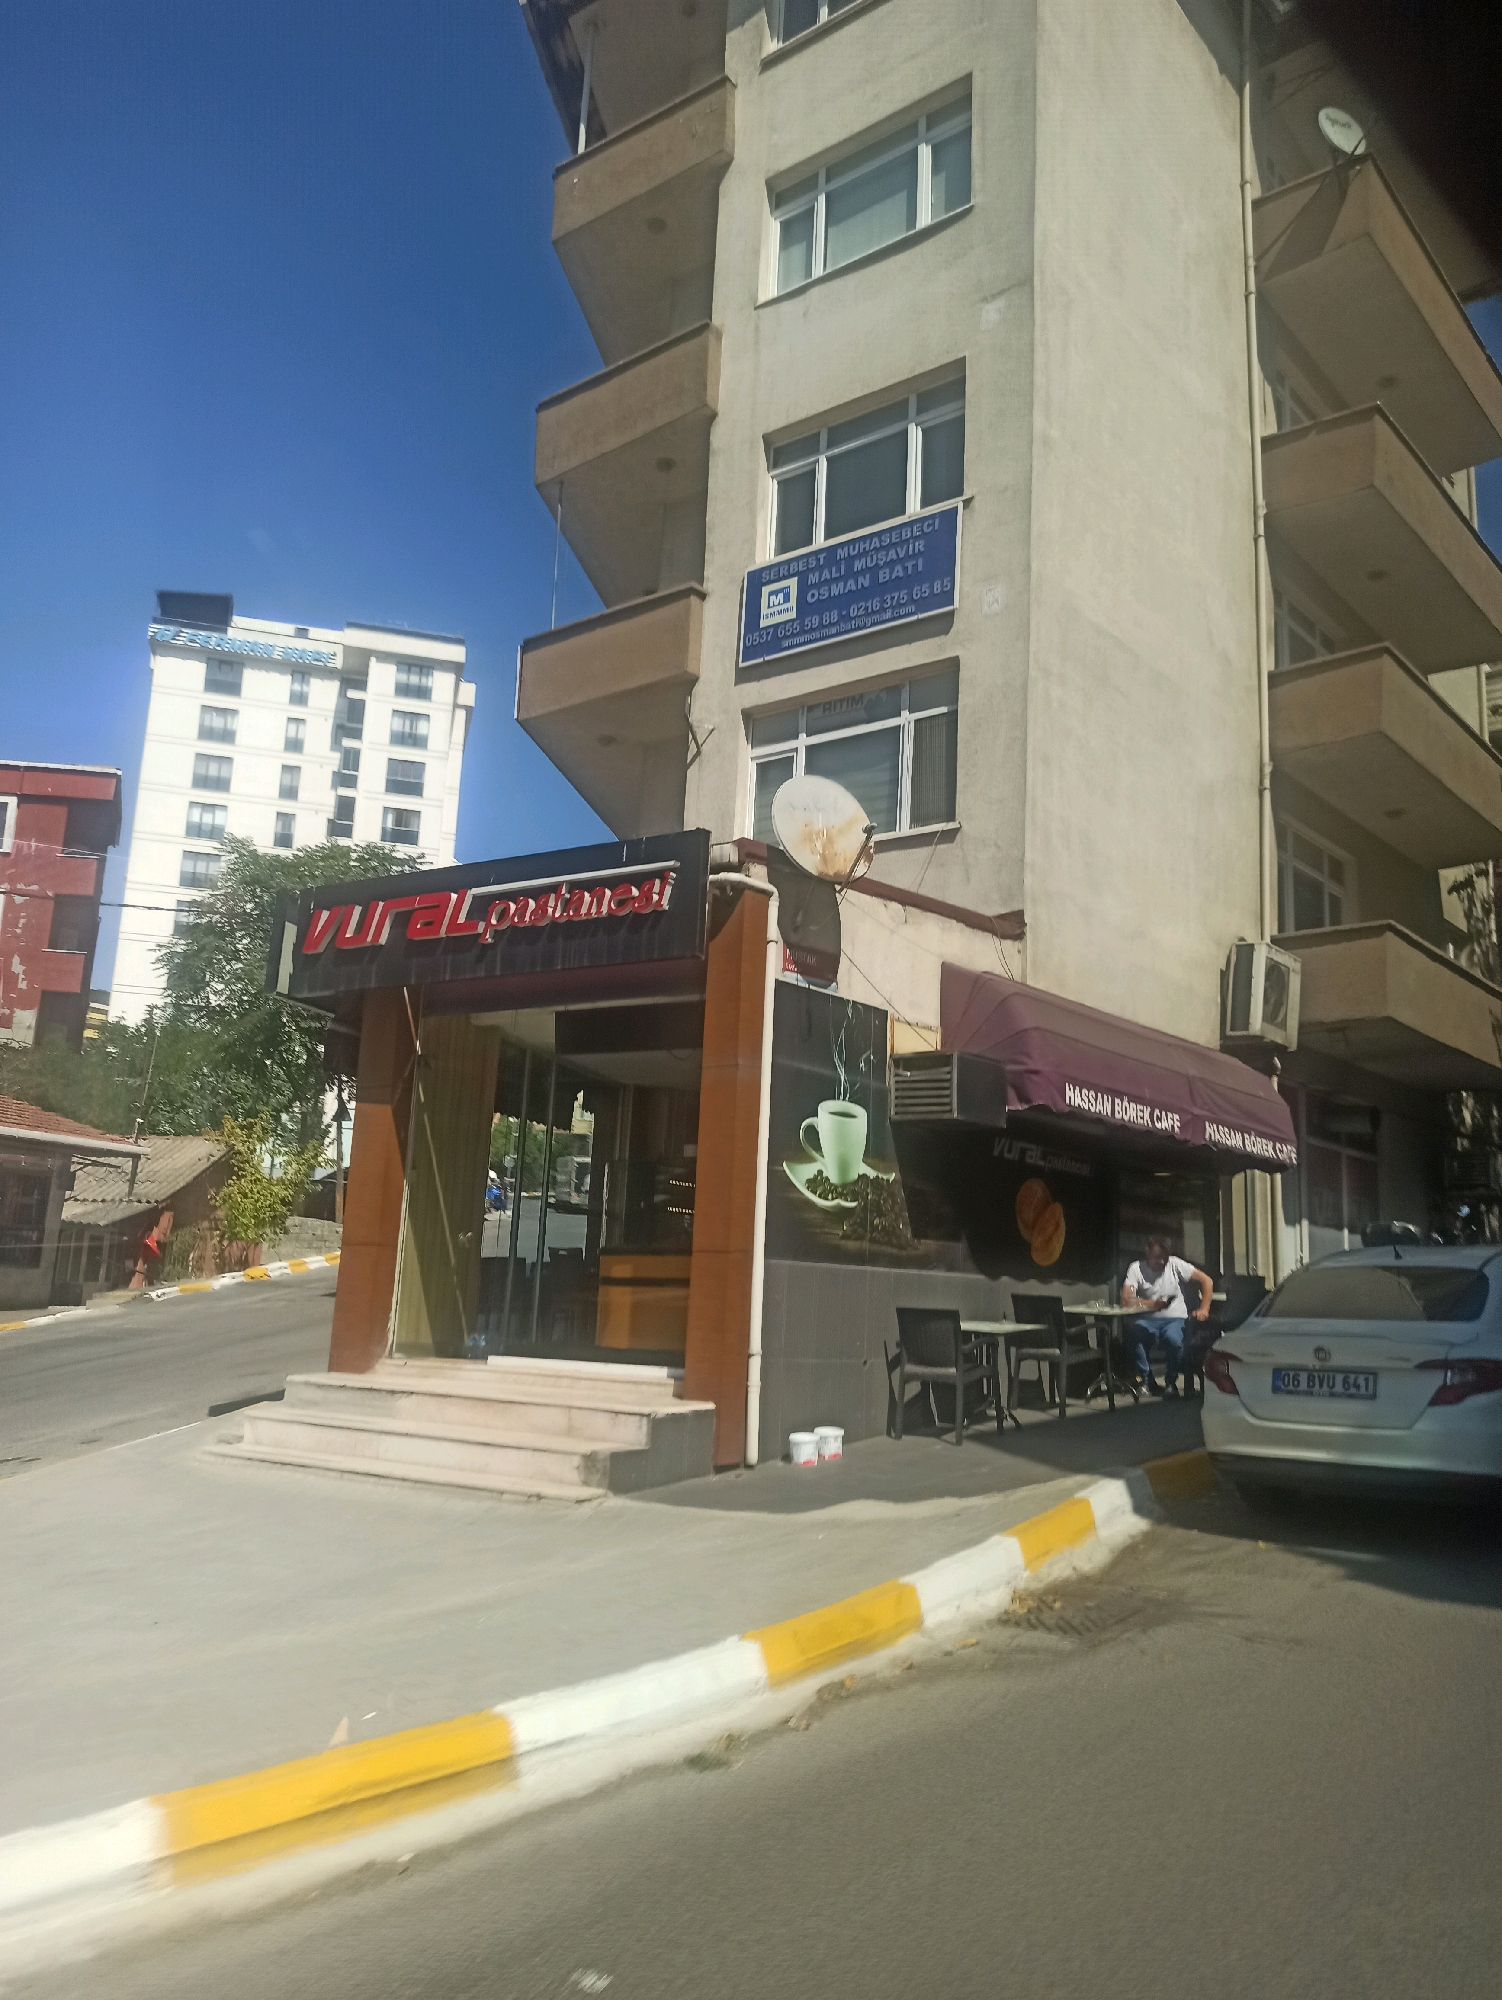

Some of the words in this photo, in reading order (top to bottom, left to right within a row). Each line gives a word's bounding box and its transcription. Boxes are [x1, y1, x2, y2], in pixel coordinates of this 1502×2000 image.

[761, 552, 828, 583] SERBEST
[836, 515, 940, 562] MUHASEBECİ
[807, 563, 846, 586] MALİ
[853, 538, 926, 573] MÜŞAVİR
[806, 573, 871, 604] OSMAN
[878, 557, 924, 584] BATI
[745, 625, 773, 648] 0537
[777, 619, 800, 639] 655
[803, 614, 819, 631] 59
[849, 597, 880, 618] 0216
[883, 588, 908, 607] 375
[912, 582, 930, 601] 65
[933, 577, 951, 596] 85
[479, 871, 677, 943] pastanesi
[1065, 1082, 1112, 1117] HASSAN
[1114, 1095, 1152, 1127] BÖREK
[1153, 1108, 1181, 1135] CAFE
[1204, 1121, 1243, 1150] HASSAN
[1244, 1130, 1276, 1159] BÖREK
[1281, 1371, 1301, 1389] 06
[1306, 1373, 1336, 1390] BVU
[1342, 1374, 1370, 1393] 641
